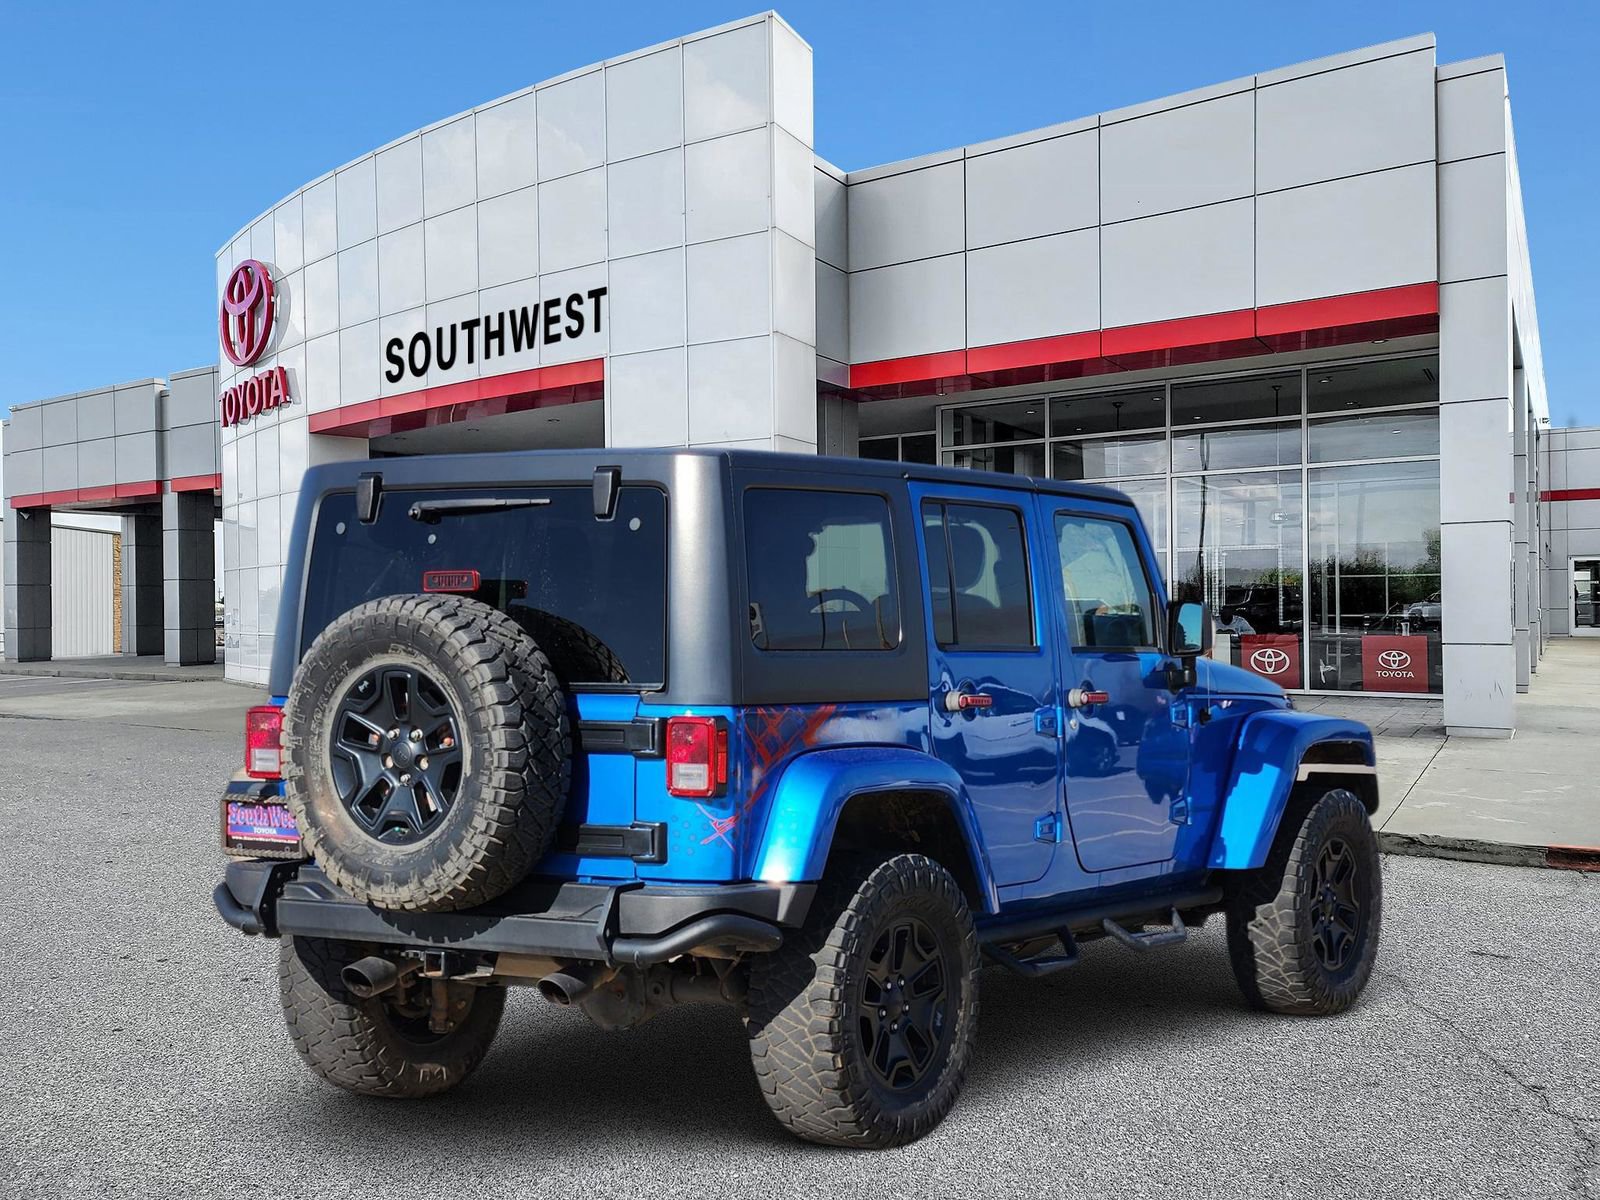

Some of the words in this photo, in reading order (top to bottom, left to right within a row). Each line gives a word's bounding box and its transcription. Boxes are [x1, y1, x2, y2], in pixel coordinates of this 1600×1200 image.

[385, 287, 608, 384] SOUTHWEST
[218, 366, 291, 428] TOYOTA
[1375, 670, 1415, 678] TOYOTA
